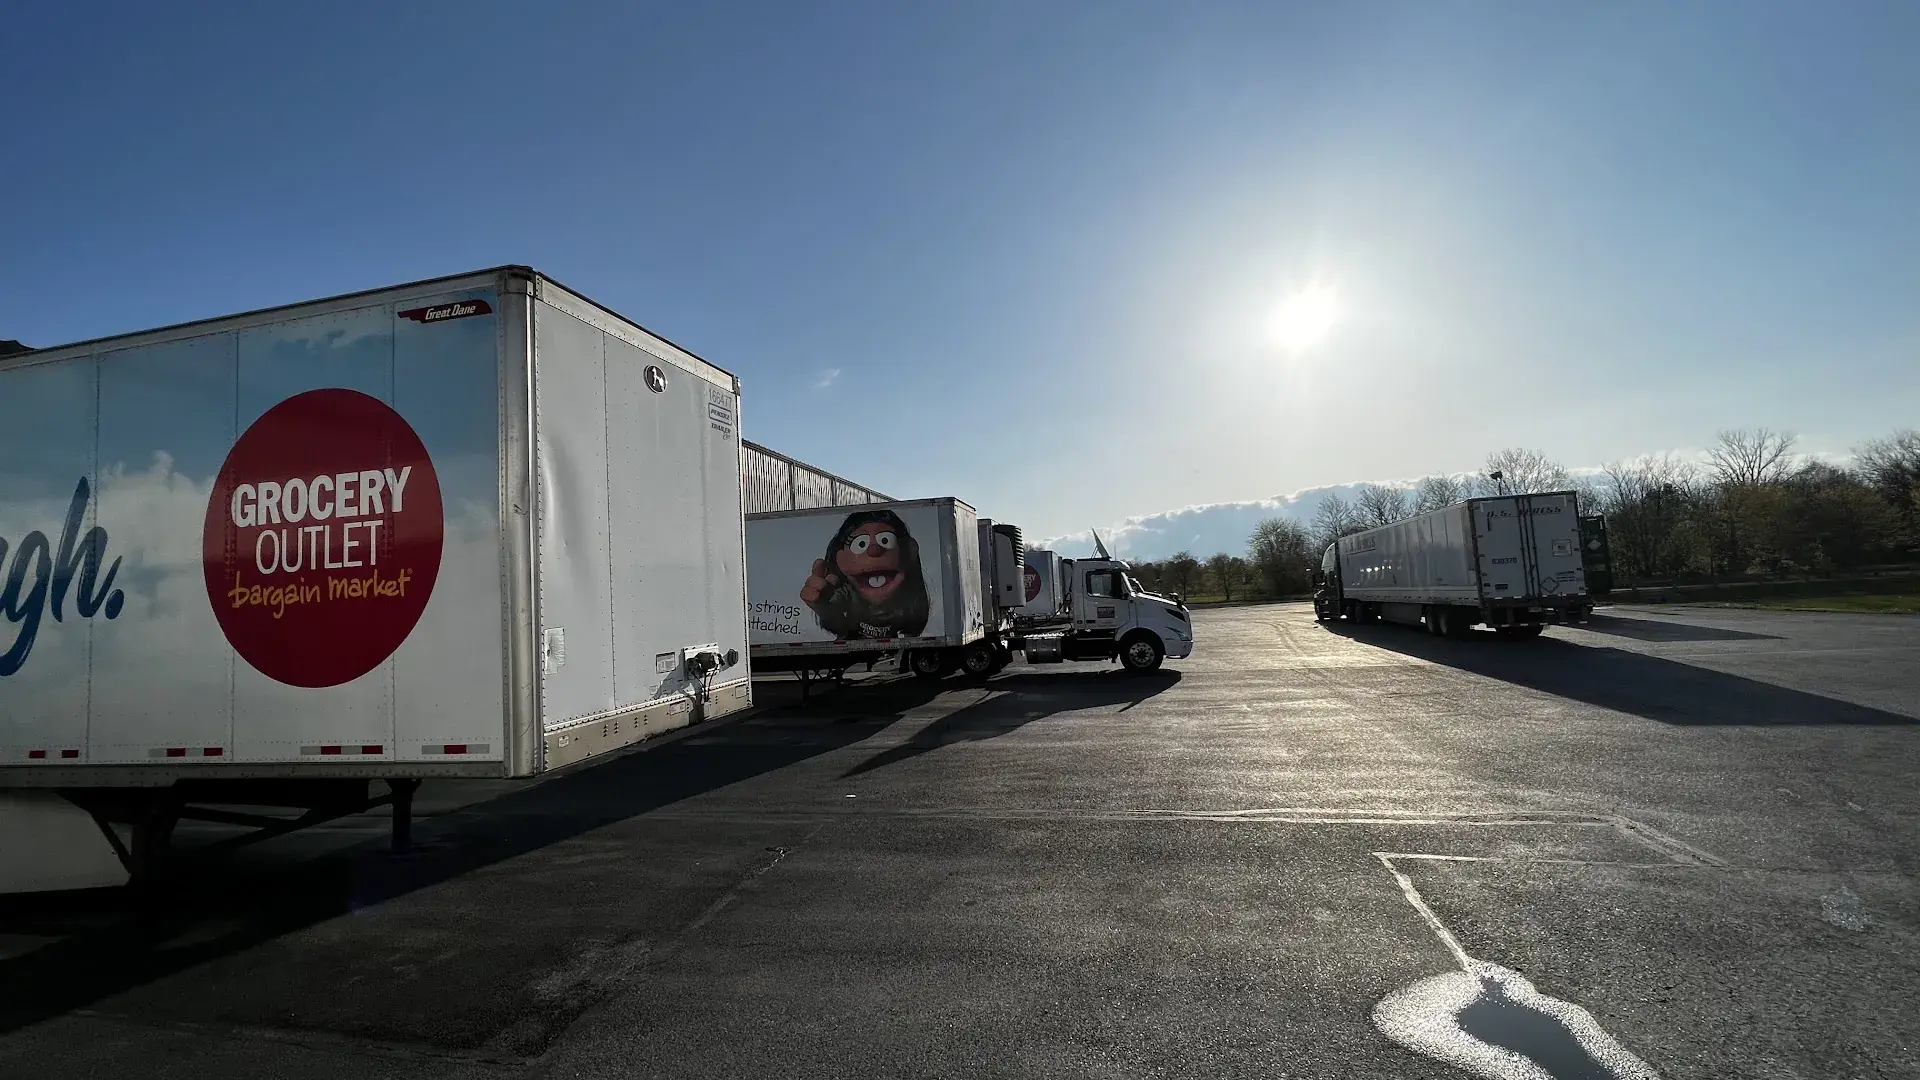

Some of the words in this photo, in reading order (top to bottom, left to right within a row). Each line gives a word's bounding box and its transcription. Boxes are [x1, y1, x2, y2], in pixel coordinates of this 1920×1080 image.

[425, 307, 451, 320] Great
[451, 303, 477, 316] Dane
[231, 466, 412, 528] GROCERY
[255, 520, 384, 575] OUTLET
[228, 570, 321, 619] bargain
[755, 599, 801, 620] strings
